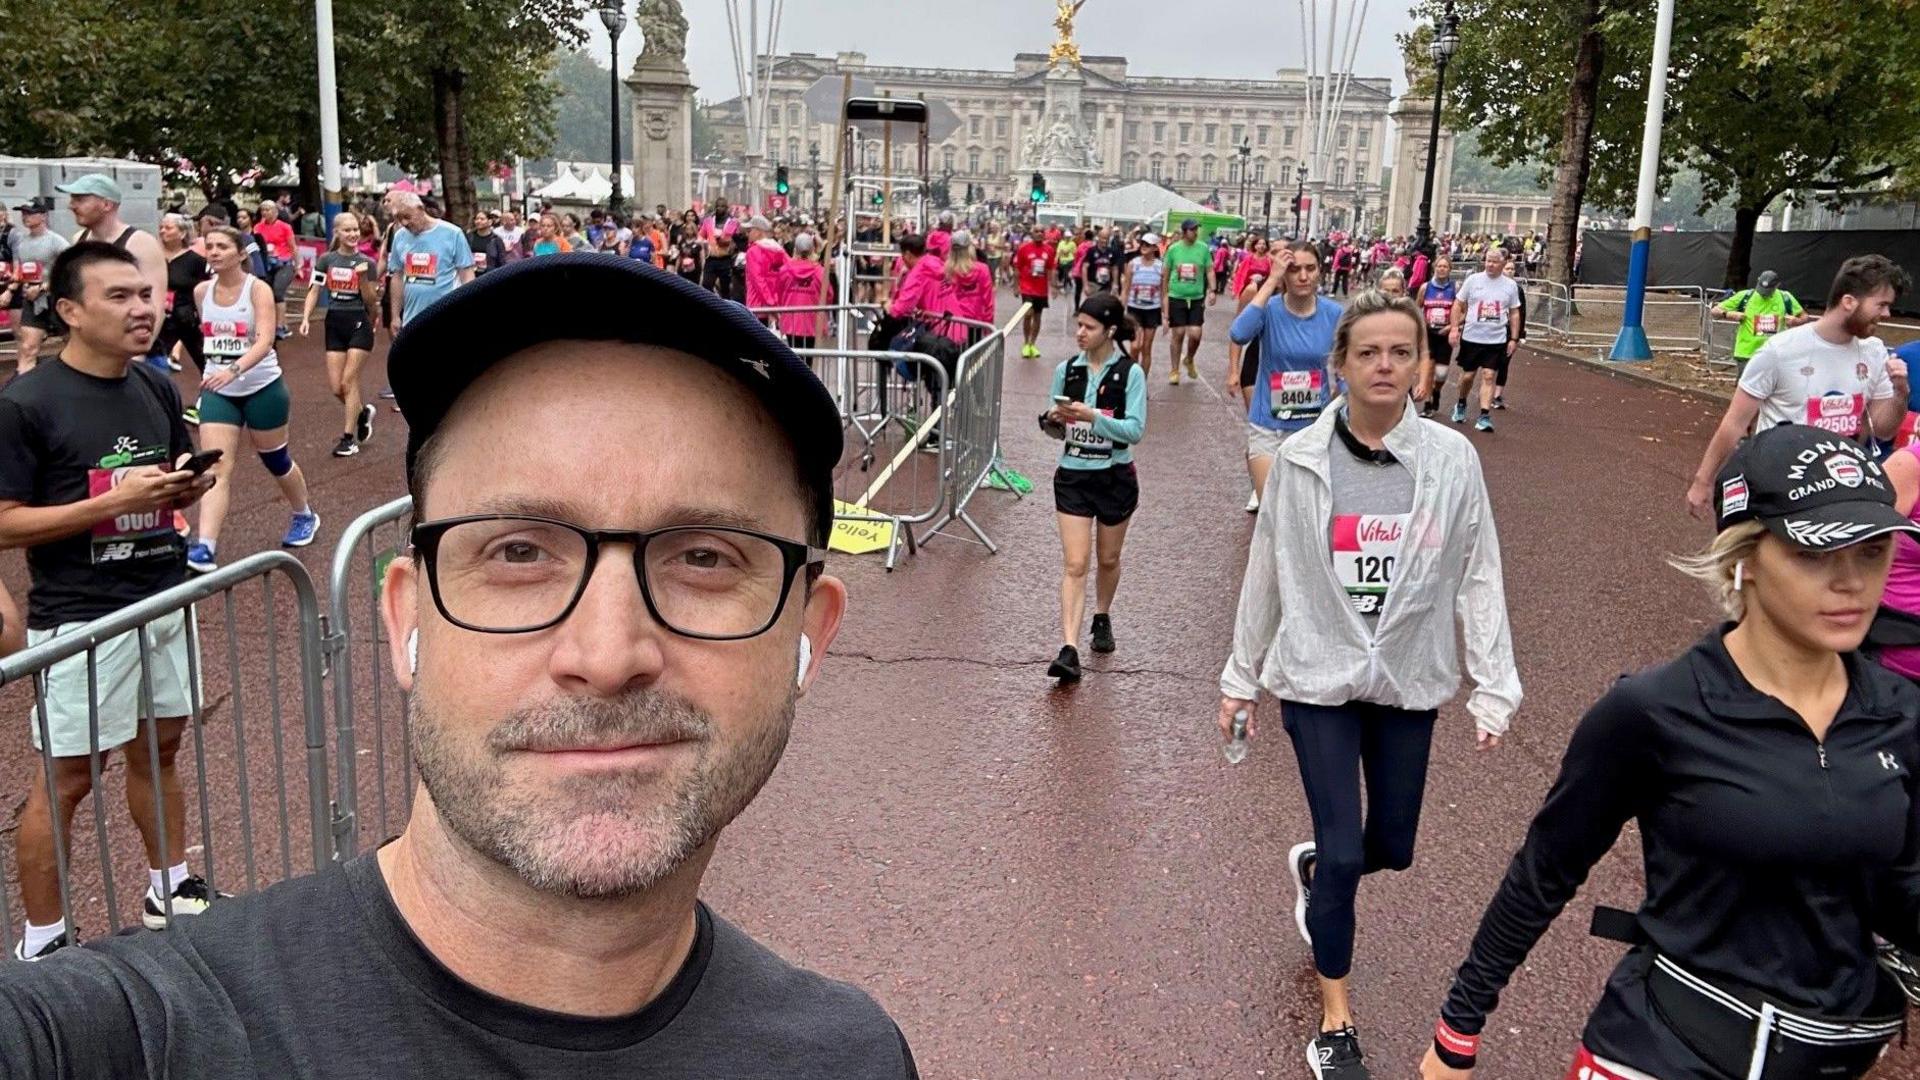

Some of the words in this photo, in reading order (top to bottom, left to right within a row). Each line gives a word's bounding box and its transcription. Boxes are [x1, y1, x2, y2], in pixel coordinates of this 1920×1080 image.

[1281, 390, 1312, 405] 8404
[1788, 477, 1836, 501] GRAND
[837, 523, 878, 542] Yello
